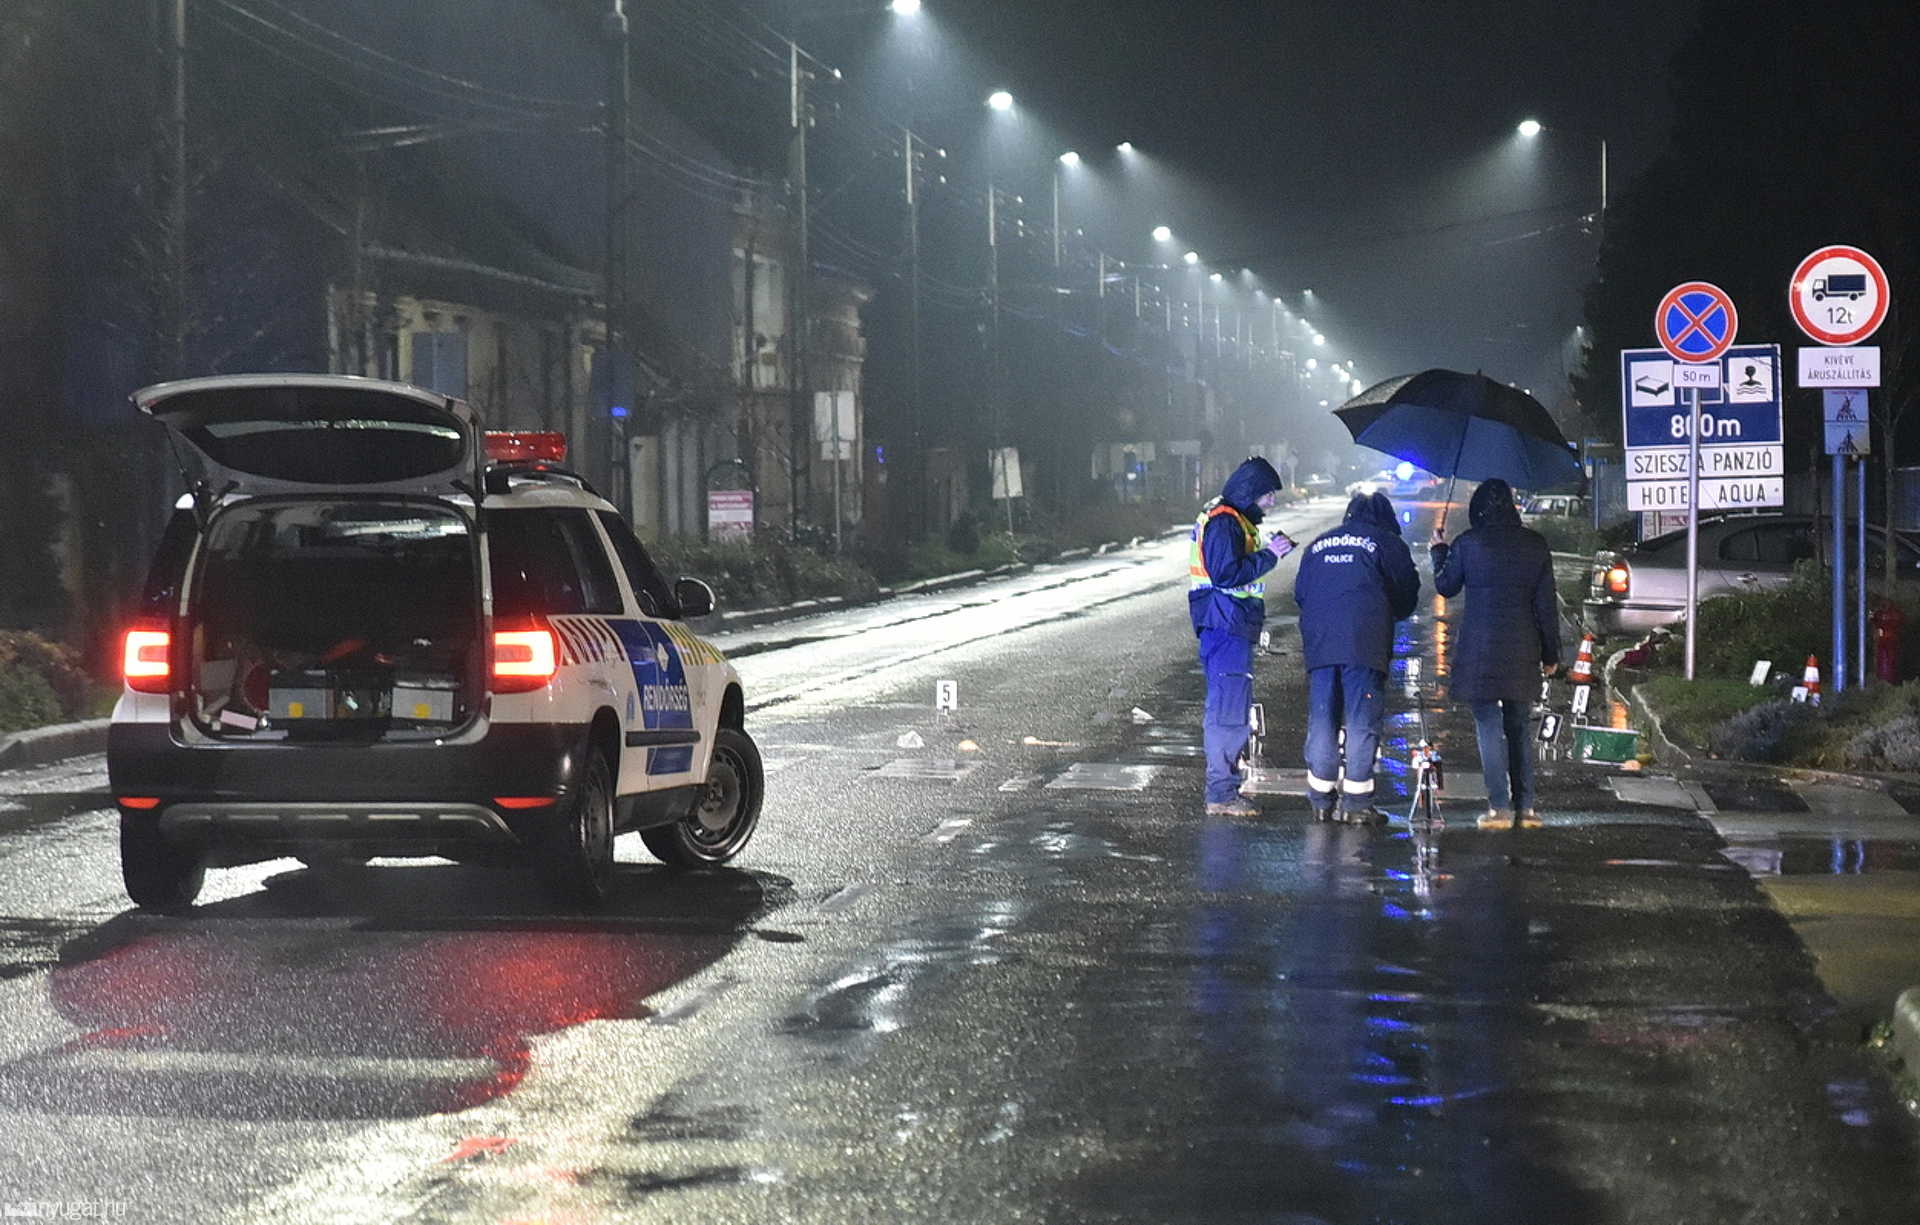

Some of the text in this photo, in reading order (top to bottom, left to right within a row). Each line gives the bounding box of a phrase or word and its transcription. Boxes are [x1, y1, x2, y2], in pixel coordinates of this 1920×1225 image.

[1633, 447, 1773, 474] SZIESZA PANZIÓ
[1641, 483, 1767, 506] HOTE AQUA
[1324, 554, 1354, 563] POLICE
[943, 684, 950, 703] 5
[1541, 715, 1557, 738] 3
